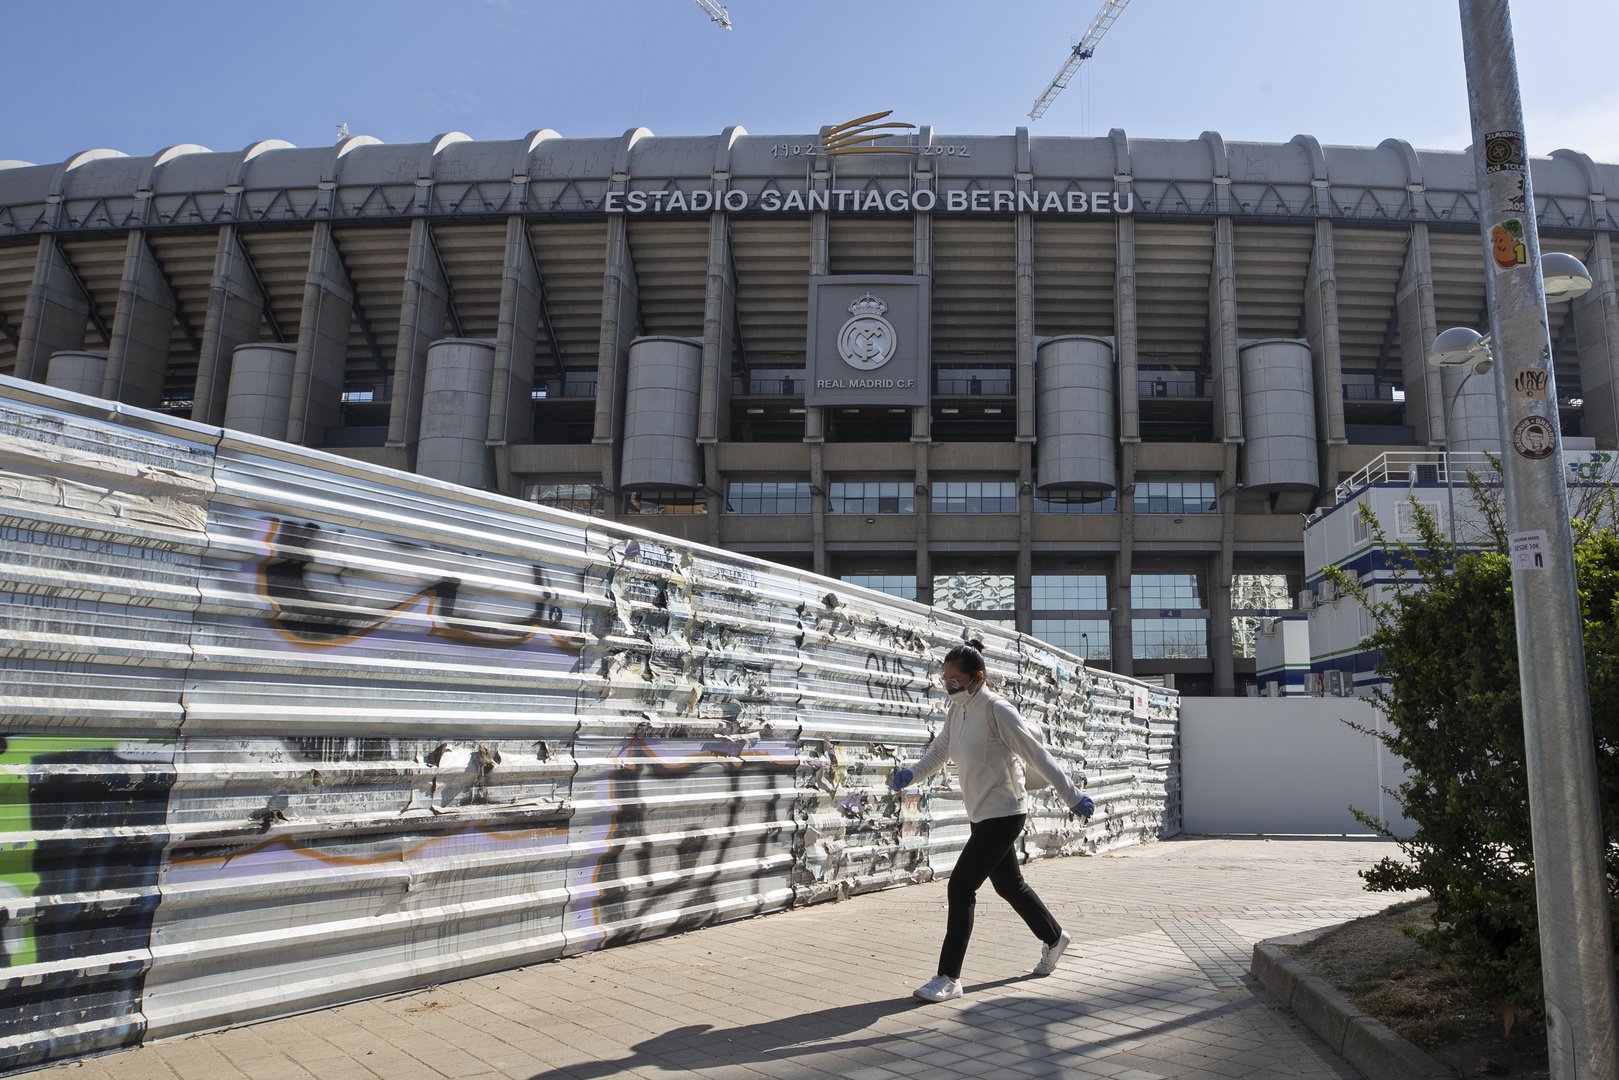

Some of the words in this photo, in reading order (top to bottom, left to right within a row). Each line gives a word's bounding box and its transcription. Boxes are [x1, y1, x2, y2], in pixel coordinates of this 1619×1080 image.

[771, 143, 817, 158] 1902
[924, 145, 970, 158] 2002
[1487, 164, 1500, 173] ON
[604, 189, 749, 213] ESTADIO
[761, 189, 936, 212] SANTIAGO
[947, 189, 1134, 214] BERNABEU
[817, 379, 846, 389] REAL
[849, 379, 894, 389] MADRID
[896, 379, 915, 389] C.F.
